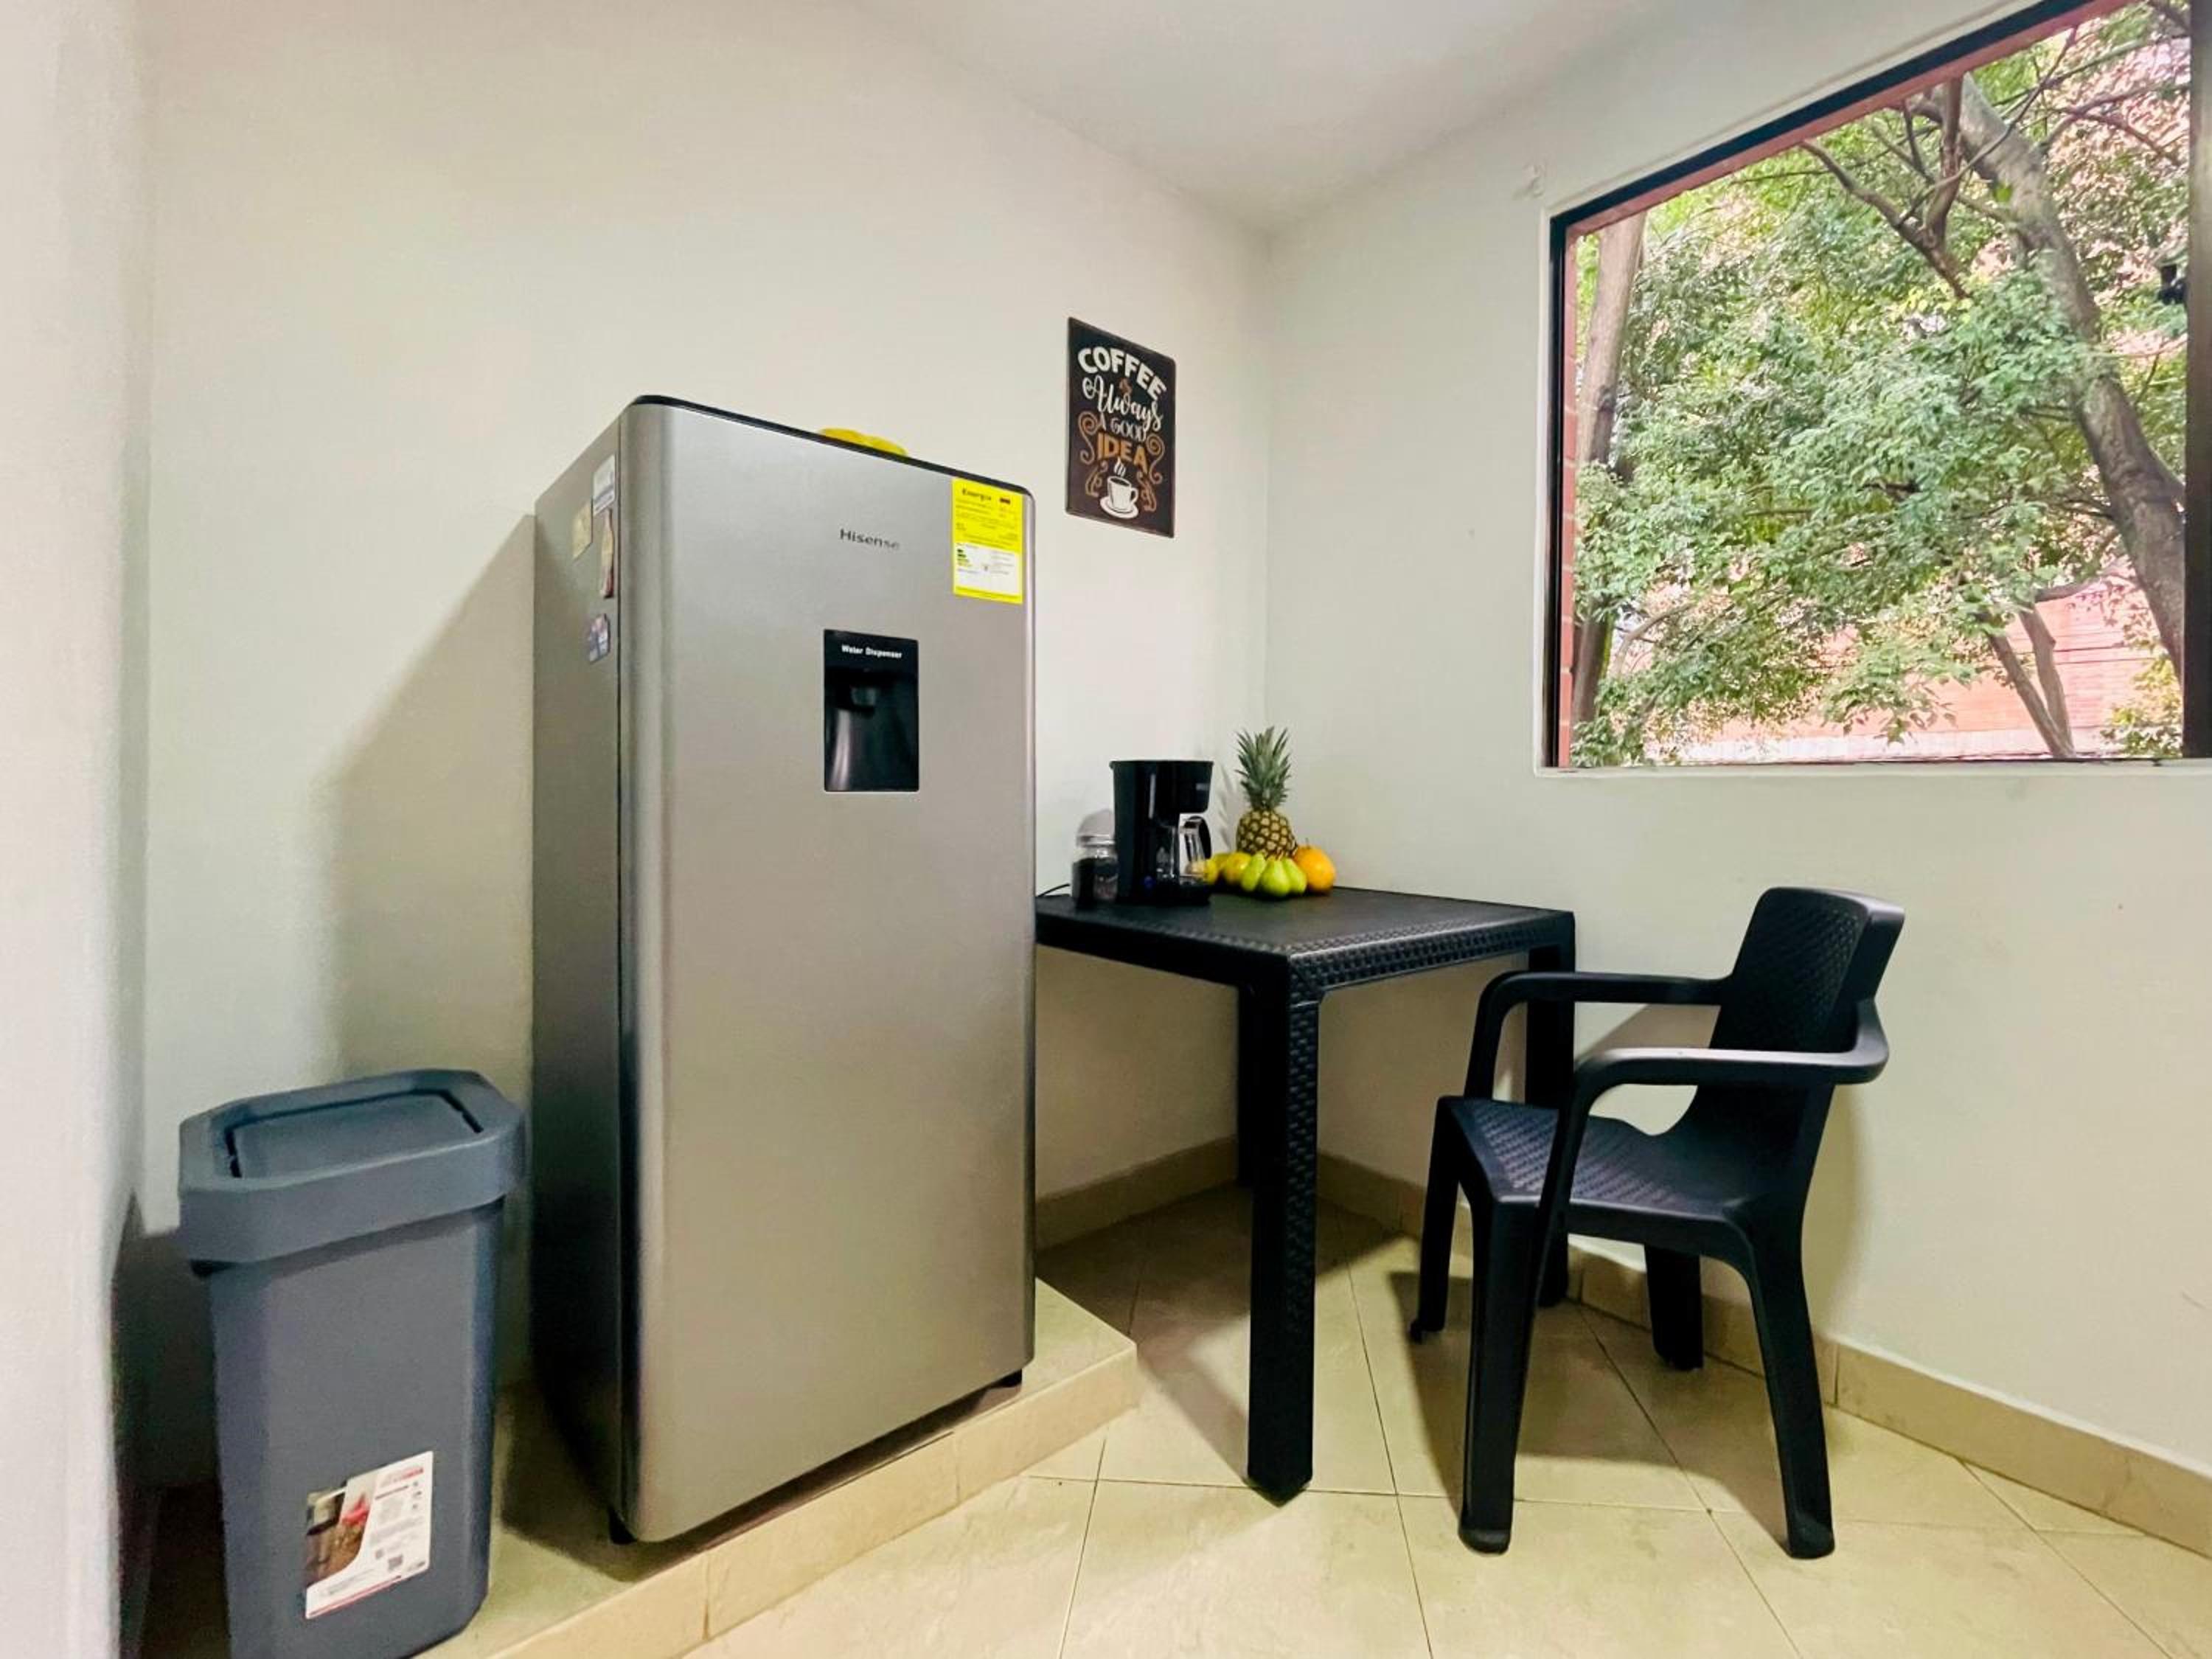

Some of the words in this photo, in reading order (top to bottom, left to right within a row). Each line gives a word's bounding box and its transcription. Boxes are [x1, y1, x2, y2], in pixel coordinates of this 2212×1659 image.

[1077, 346, 1167, 401] COFFEE
[1082, 375, 1164, 432] Always
[1097, 431, 1149, 476] IDEA
[840, 527, 900, 551] Hisense
